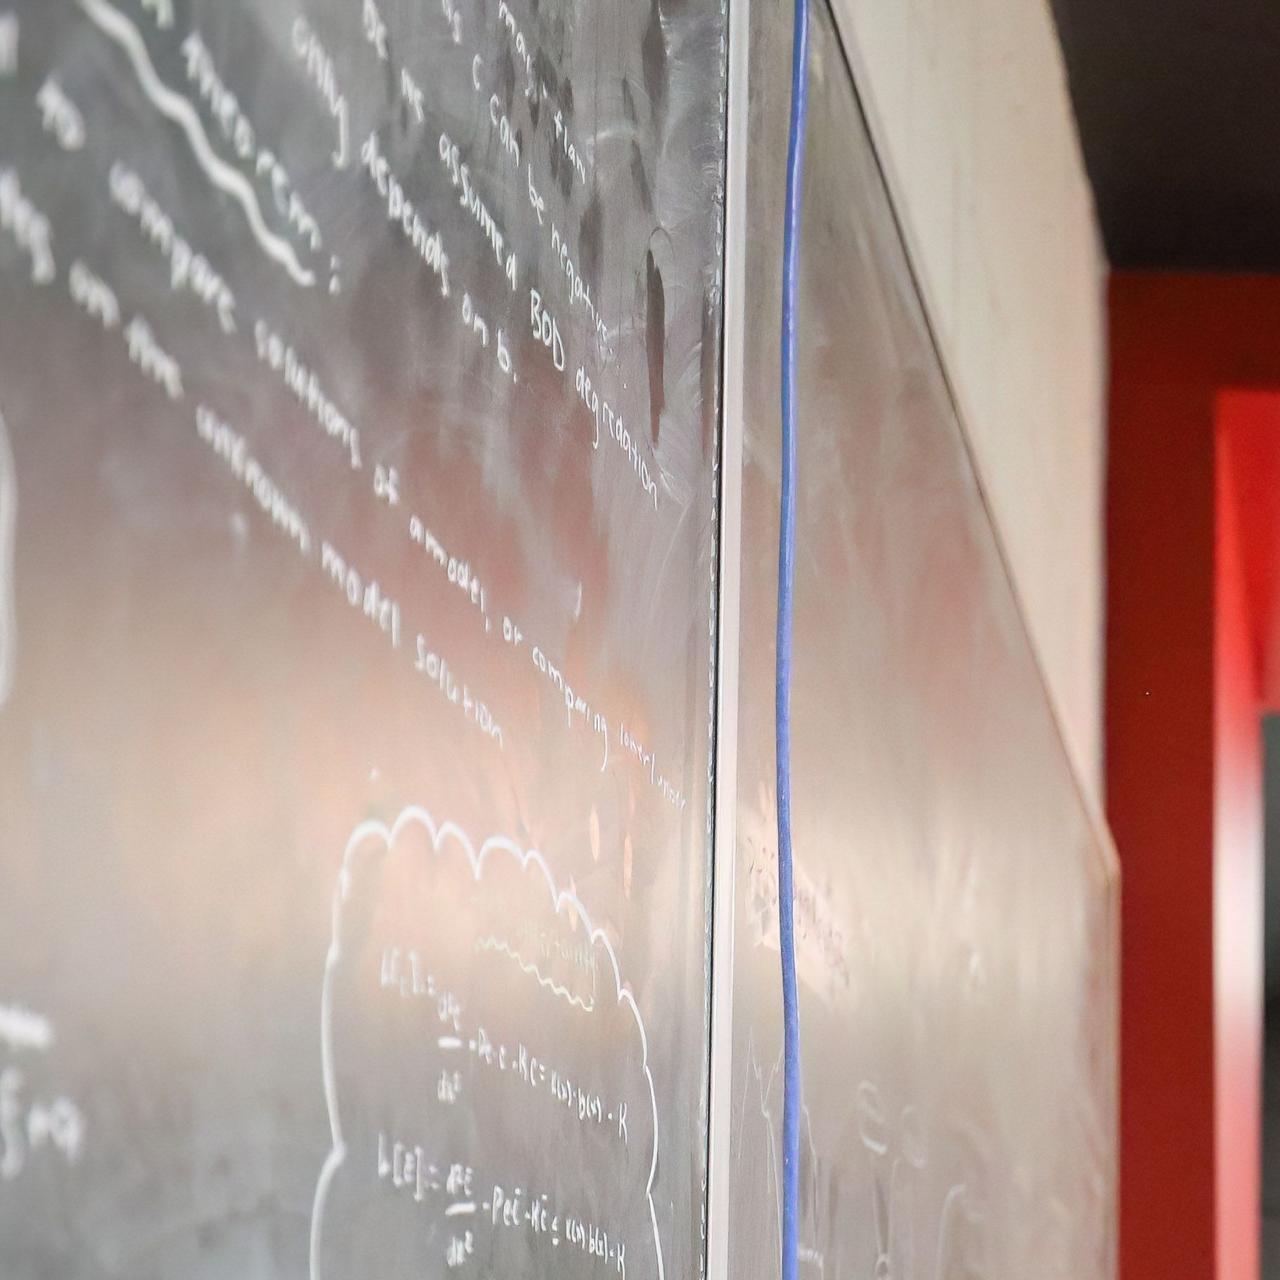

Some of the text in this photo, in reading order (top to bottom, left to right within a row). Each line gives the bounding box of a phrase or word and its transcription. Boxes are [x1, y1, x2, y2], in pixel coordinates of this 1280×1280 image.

[291, 15, 349, 171] only
[361, 131, 450, 298] depends
[461, 292, 490, 348] on
[438, 131, 517, 291] assumed
[530, 287, 566, 372] BOD
[489, 94, 520, 167] can
[527, 163, 546, 225] be
[109, 160, 238, 335] compare
[252, 319, 363, 470] solutions
[374, 463, 401, 507] of
[502, 615, 524, 647] or
[531, 645, 608, 773] comparing
[195, 403, 313, 555] unknown
[320, 543, 402, 649] model
